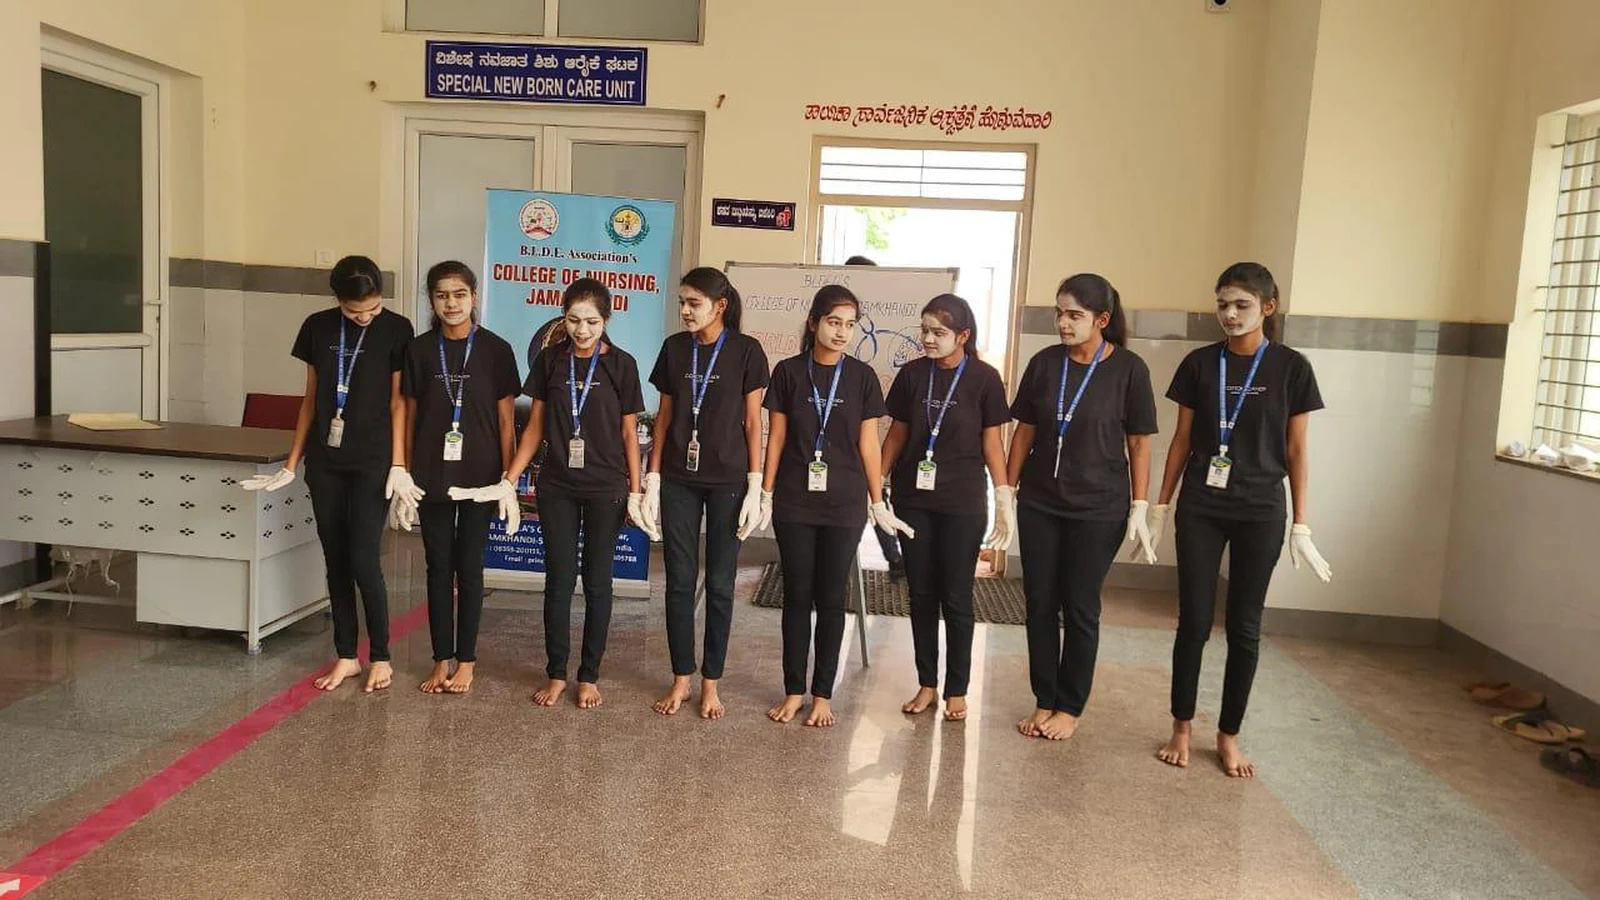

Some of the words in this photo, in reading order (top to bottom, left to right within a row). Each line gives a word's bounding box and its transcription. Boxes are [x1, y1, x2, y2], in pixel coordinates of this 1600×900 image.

[435, 51, 474, 68] ವಿಶೇಷ
[479, 52, 529, 68] ನವಜಾತ
[533, 53, 559, 69] ಶಿಶು
[564, 54, 601, 77] ಆರೈಕೆ
[605, 56, 639, 72] ಘಟಕ
[437, 73, 491, 93] SPECIAL
[494, 76, 524, 95] NEW
[526, 77, 564, 96] BORN
[566, 78, 602, 97] CARE
[605, 80, 636, 99] UNIT
[567, 249, 638, 264] Association's
[493, 263, 557, 285] COLLEGE
[562, 268, 581, 285] OF
[585, 270, 660, 294] NURSING,
[526, 288, 629, 311] JAMDI
